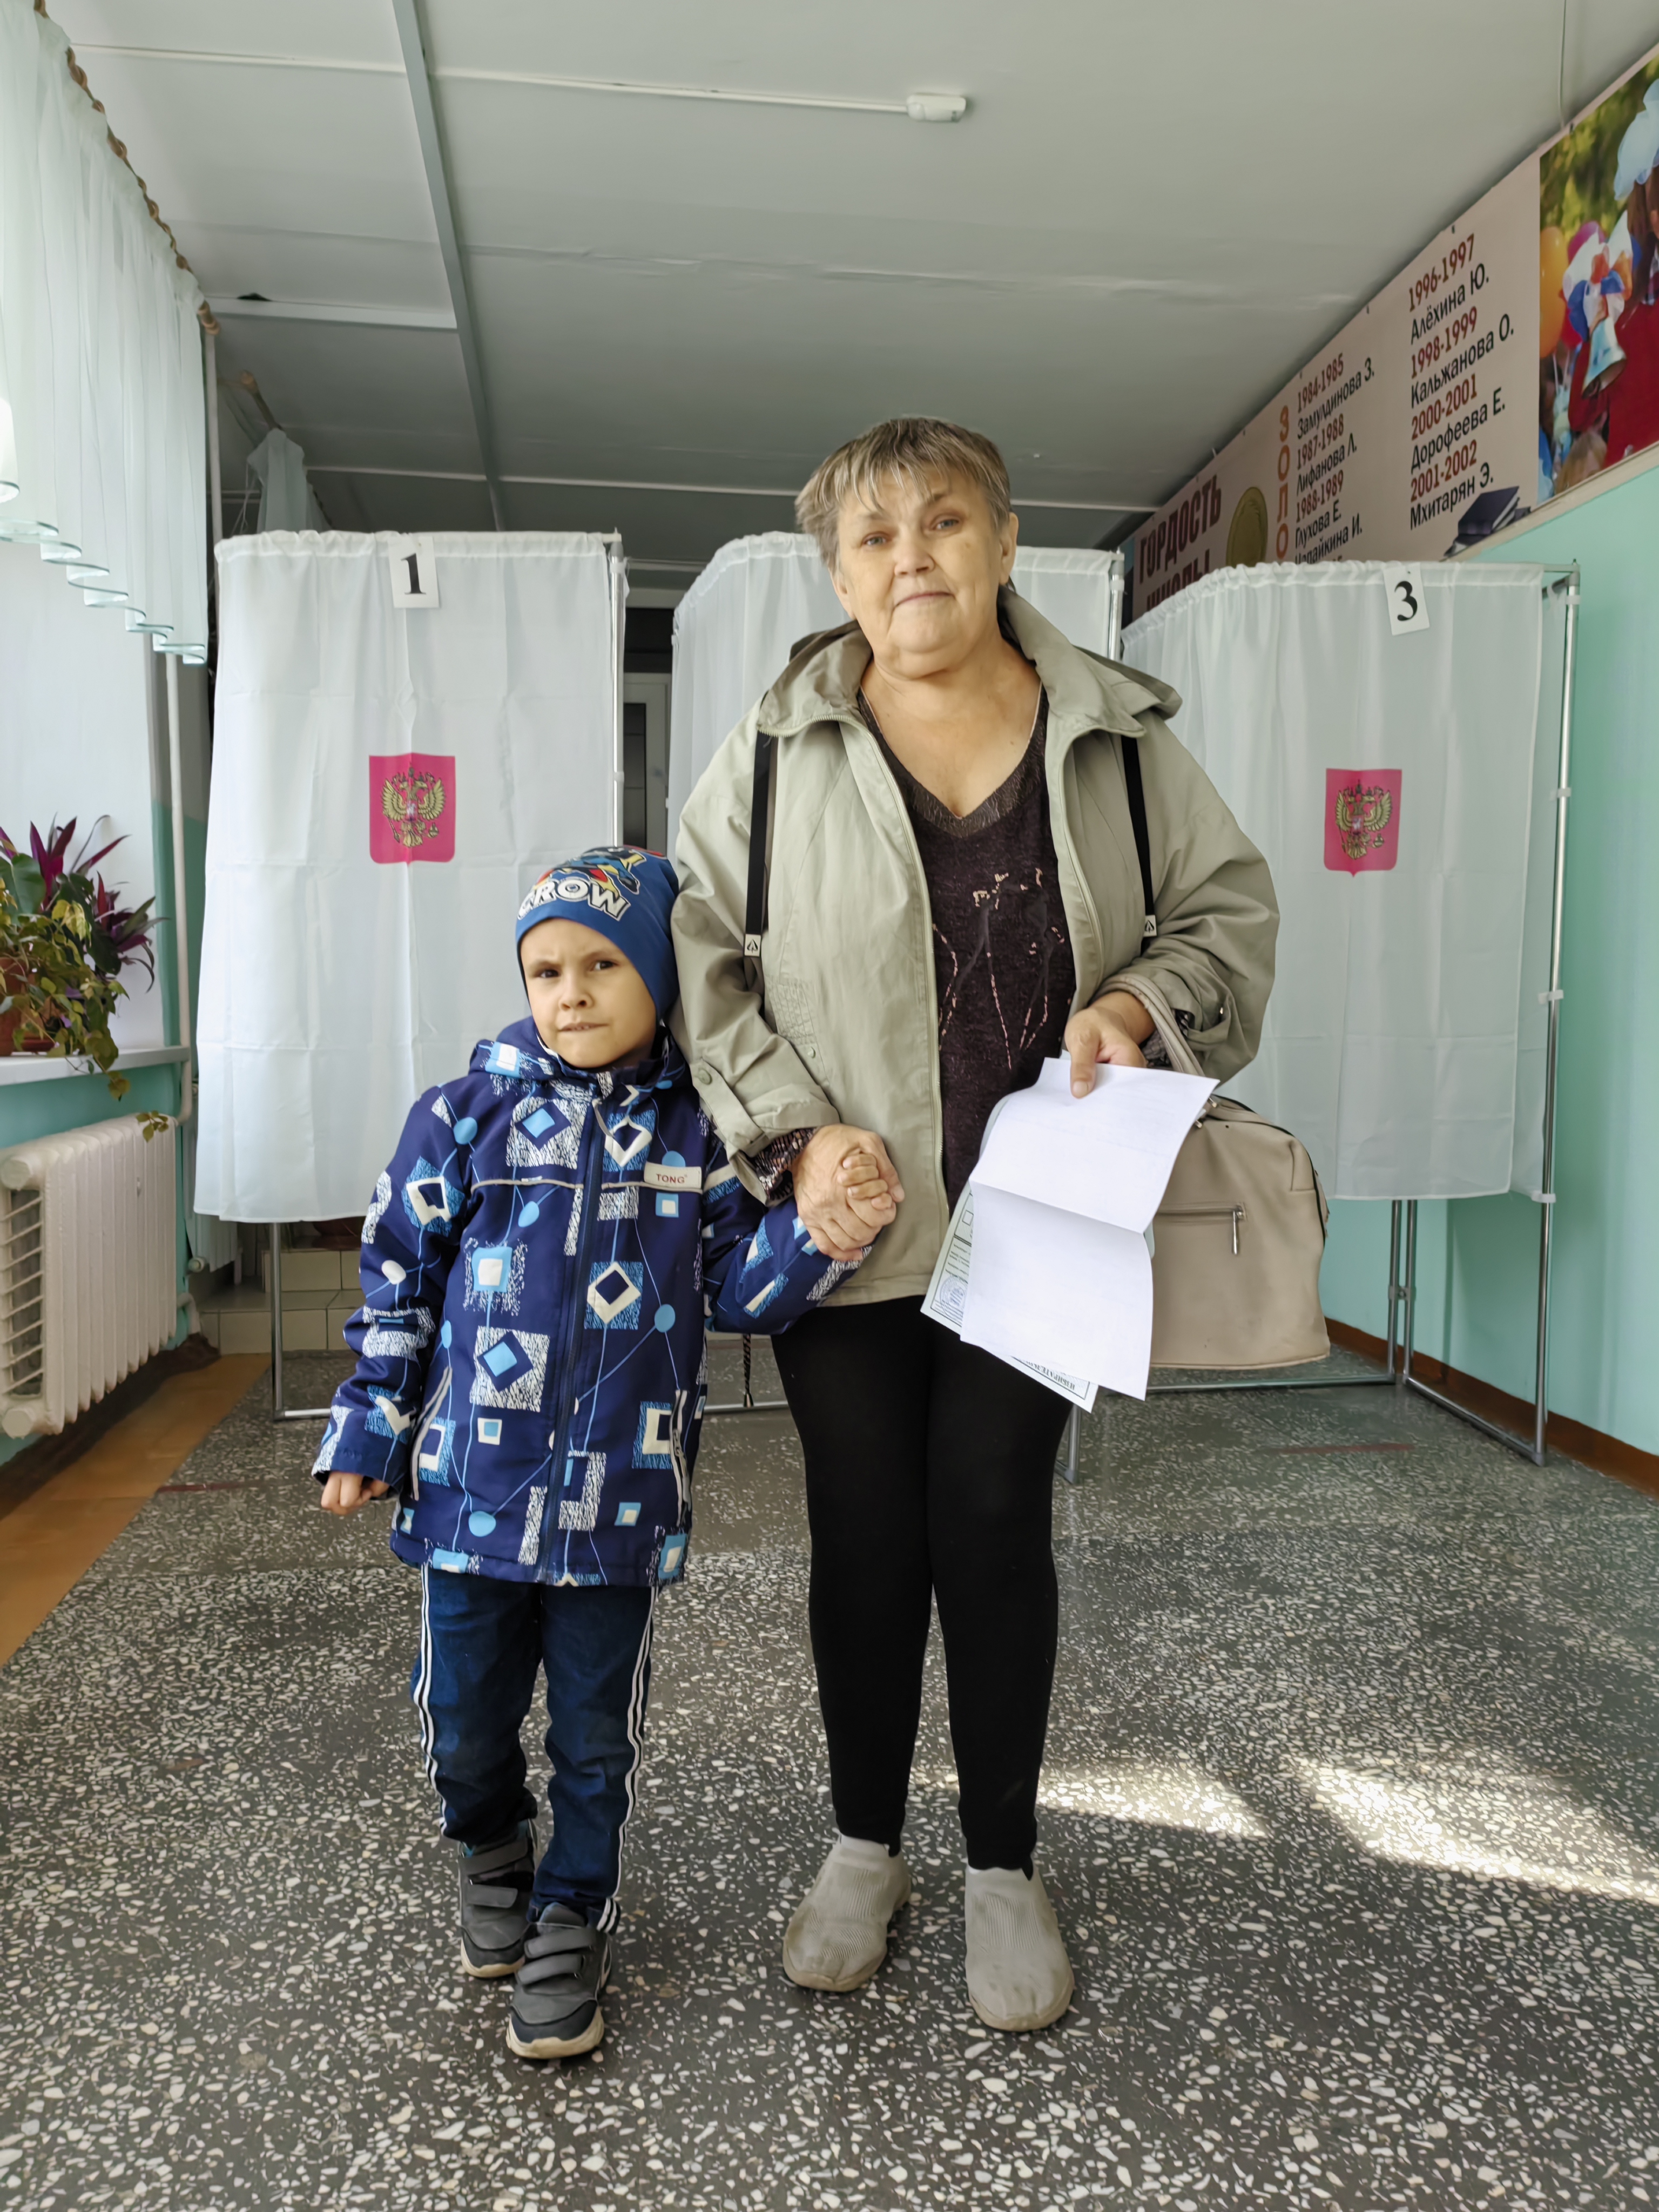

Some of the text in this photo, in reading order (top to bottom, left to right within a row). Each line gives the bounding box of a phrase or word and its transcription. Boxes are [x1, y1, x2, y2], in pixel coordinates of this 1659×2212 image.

[1408, 232, 1475, 312] 1996-1997
[1411, 262, 1489, 346] Алёхина Ю.
[1364, 356, 1375, 382] З.
[1411, 306, 1478, 379] 1998-1999
[1411, 313, 1514, 409] Кальжанова О.
[1297, 352, 1344, 414] 1984-1985
[1411, 373, 1478, 441] 2000-2001
[1297, 413, 1344, 470] 1987-1988
[1411, 386, 1506, 475] Дорофеева Е.
[1296, 432, 1358, 497] Лифанова Л.
[1296, 469, 1344, 524] 1988-1989
[1410, 439, 1478, 503] 2001-2002
[1410, 461, 1494, 531] Мхитарян Э.
[1139, 474, 1222, 585] ГОРДОСТЬ
[1295, 498, 1342, 549] Глухова Е.
[1352, 512, 1363, 539] И.
[400, 552, 427, 595] 1
[1394, 580, 1418, 622] 3
